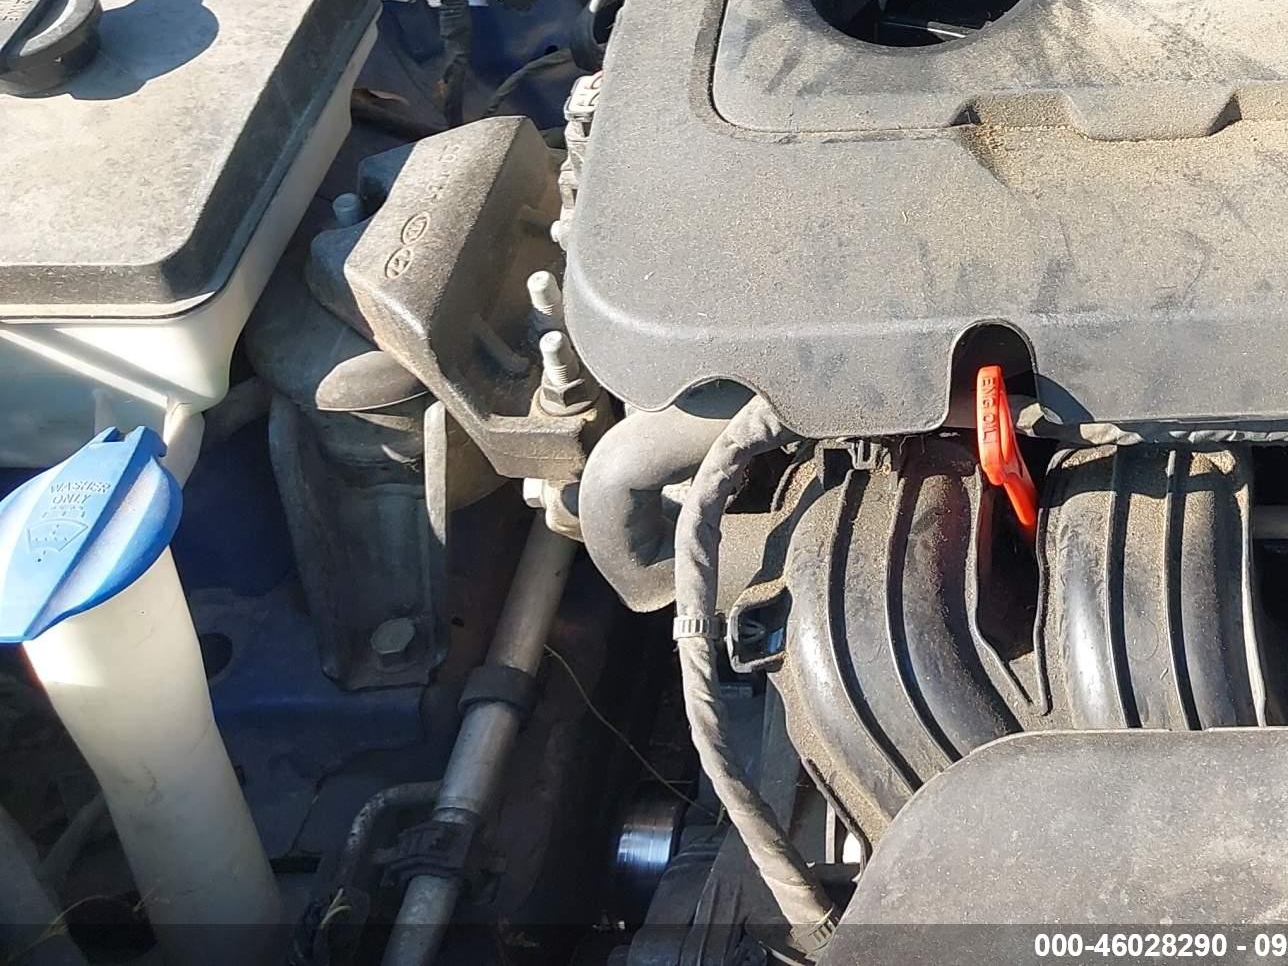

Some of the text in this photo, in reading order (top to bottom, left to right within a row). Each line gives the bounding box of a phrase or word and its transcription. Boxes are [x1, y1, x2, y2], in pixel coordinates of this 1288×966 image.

[982, 377, 998, 443] ENG OIL
[50, 480, 111, 493] WASHER
[52, 494, 91, 504] ONLY
